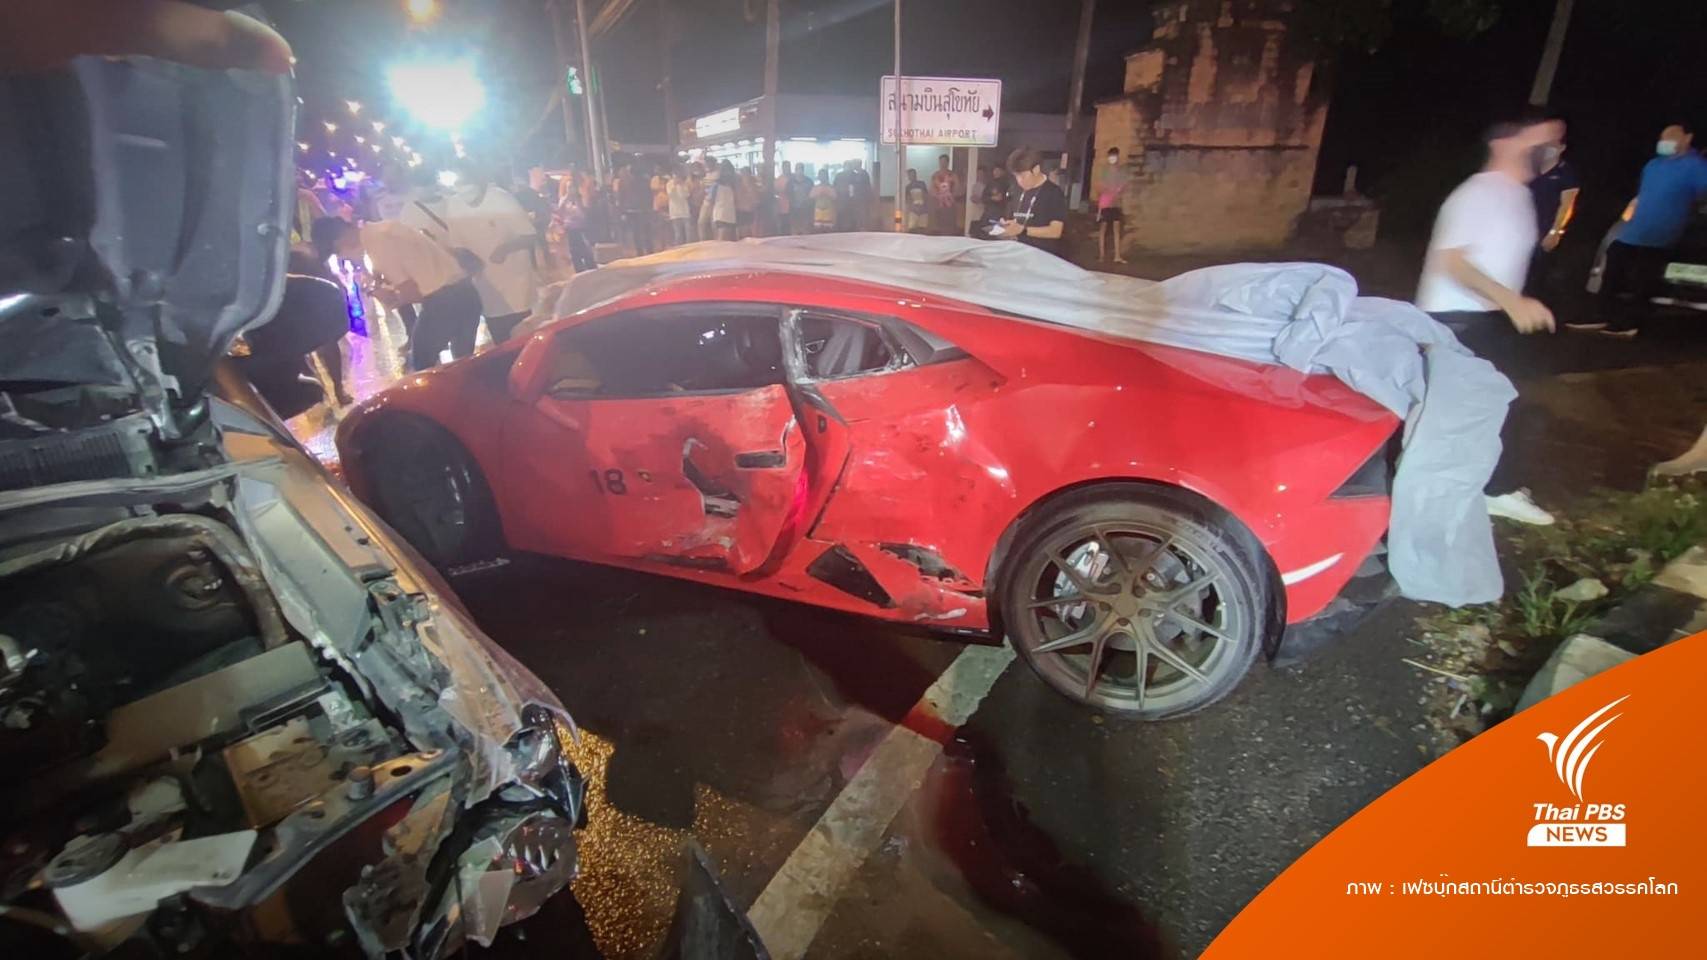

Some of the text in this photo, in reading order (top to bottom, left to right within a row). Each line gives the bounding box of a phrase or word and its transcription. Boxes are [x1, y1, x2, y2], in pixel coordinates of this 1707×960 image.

[888, 87, 980, 120] สนามบินสุโขทัย
[938, 129, 977, 139] AIRPORT
[590, 468, 628, 496] 18
